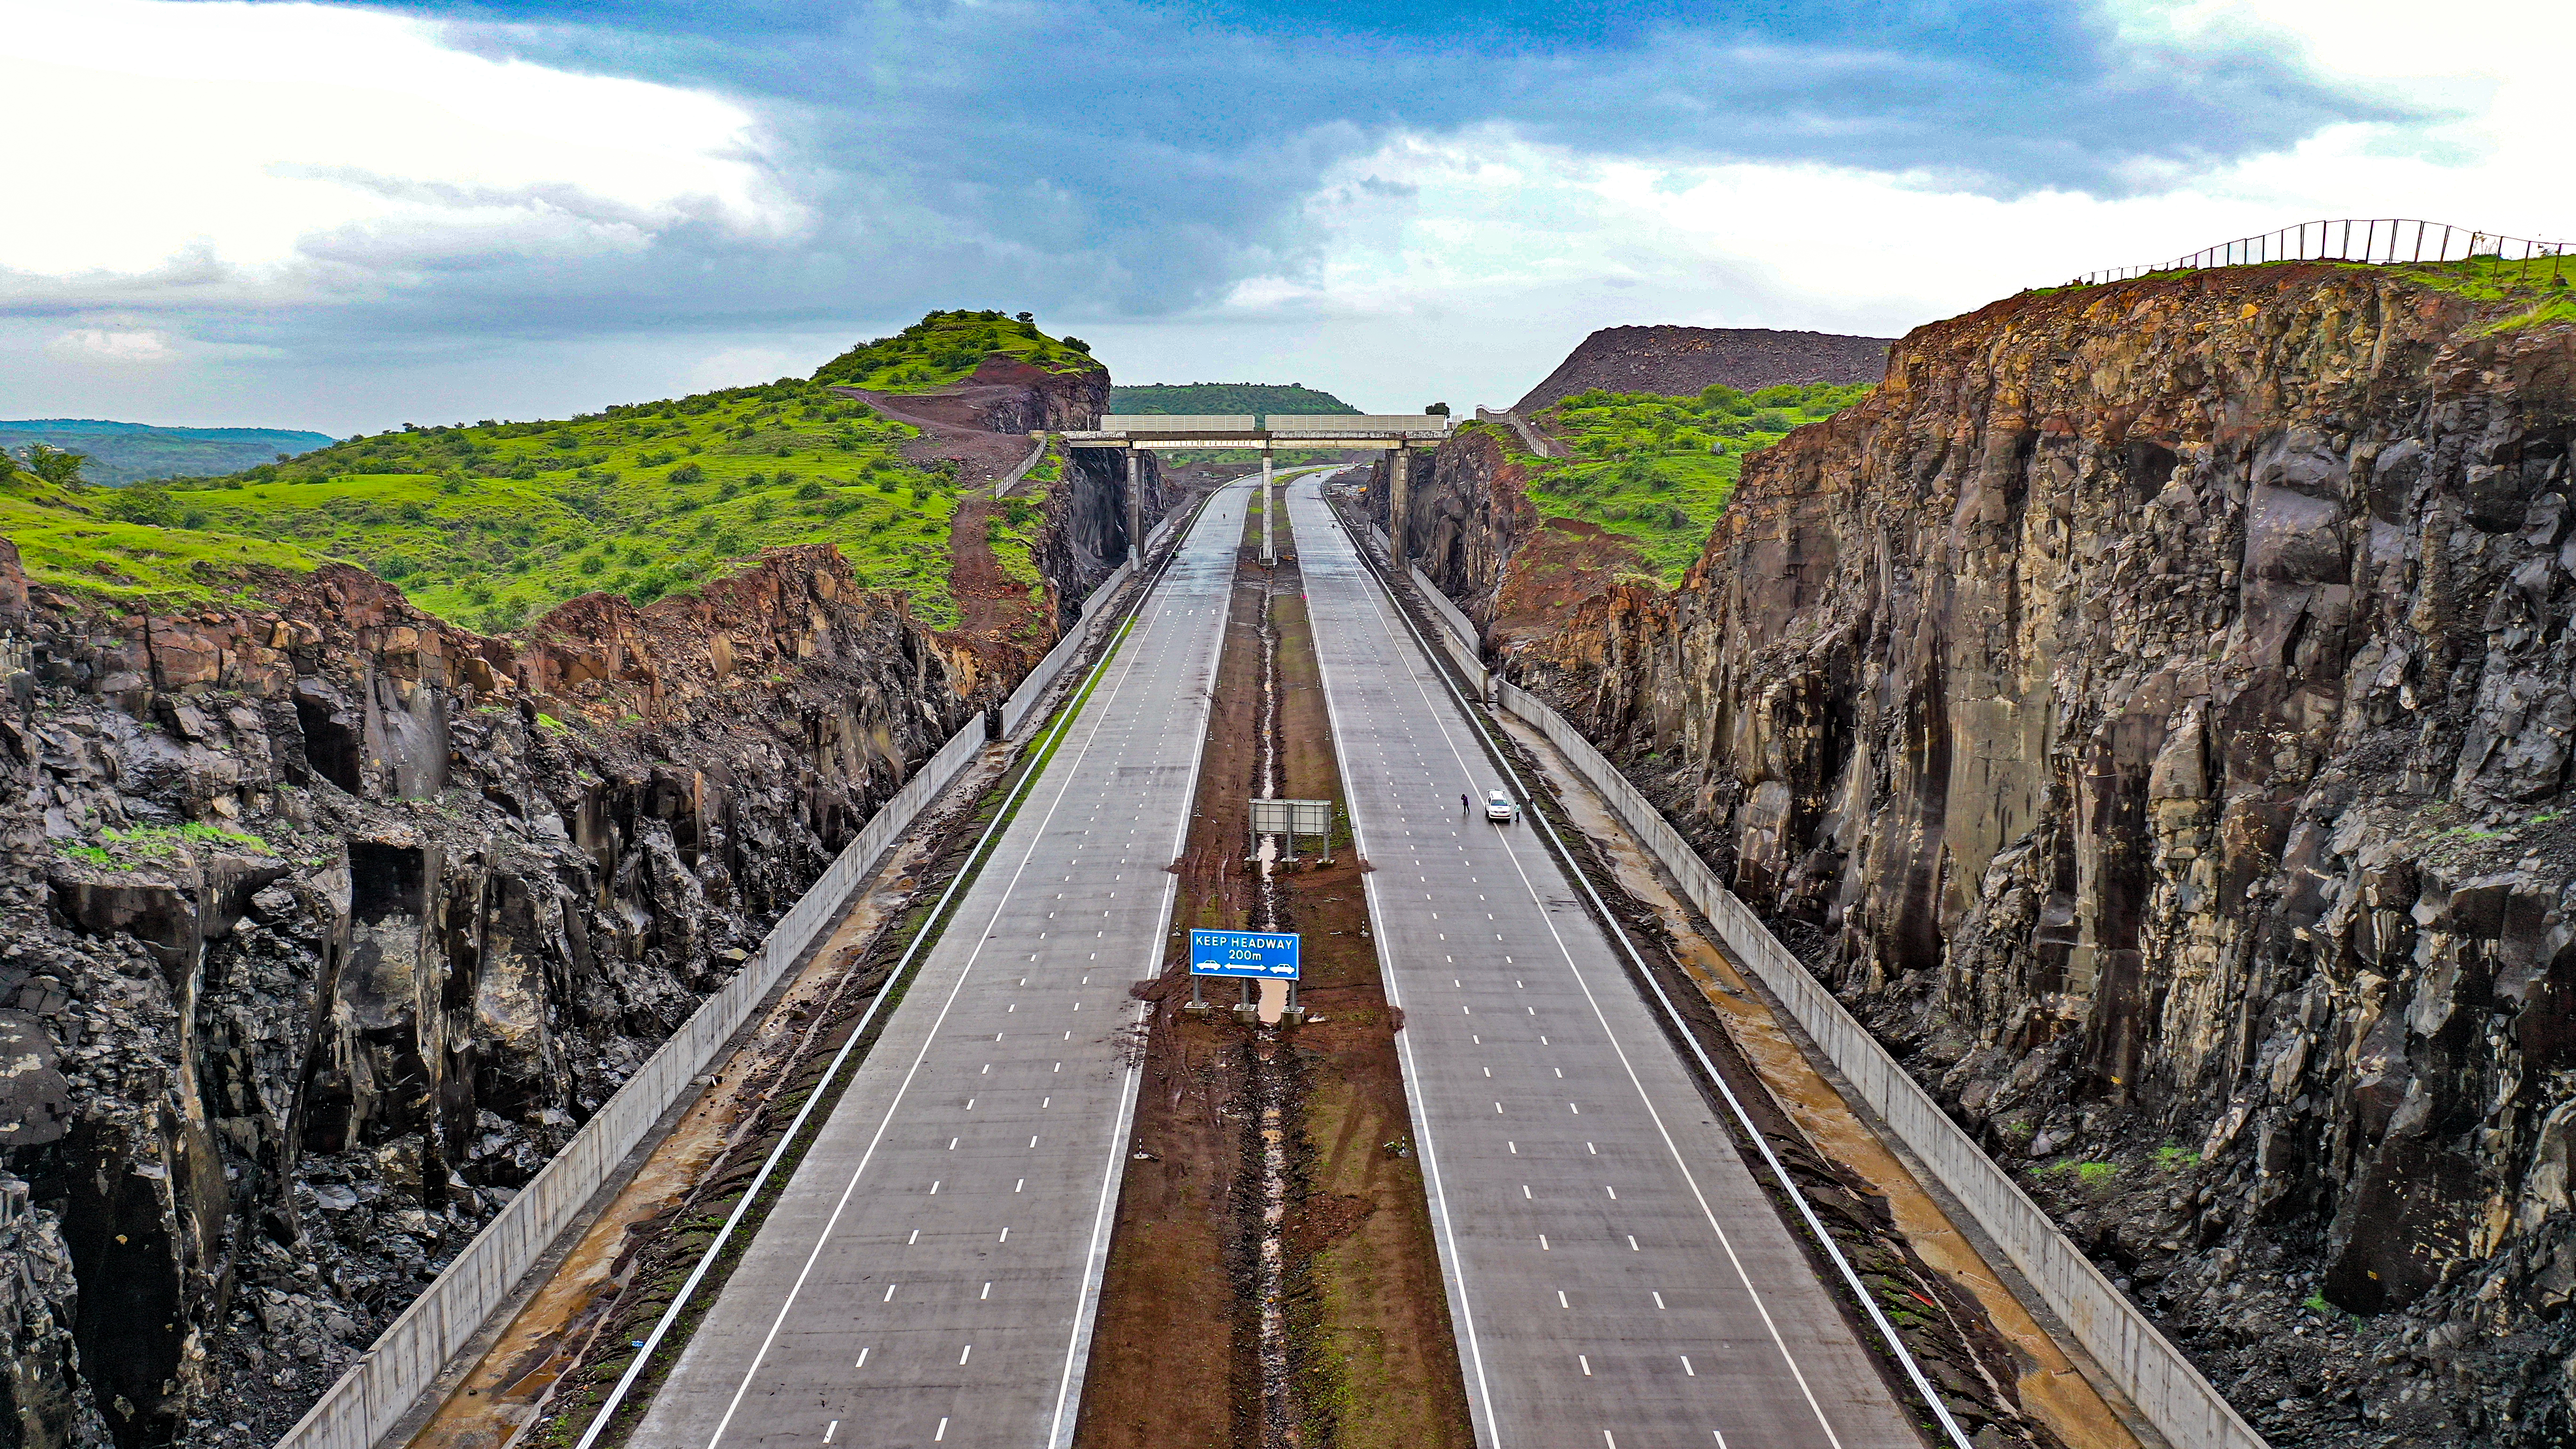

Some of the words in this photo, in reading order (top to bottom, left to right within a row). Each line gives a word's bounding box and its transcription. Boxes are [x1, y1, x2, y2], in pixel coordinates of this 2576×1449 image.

[1196, 936, 1227, 946] KEEP
[1232, 937, 1293, 950] HEADWAY
[1229, 950, 1262, 960] 200m
